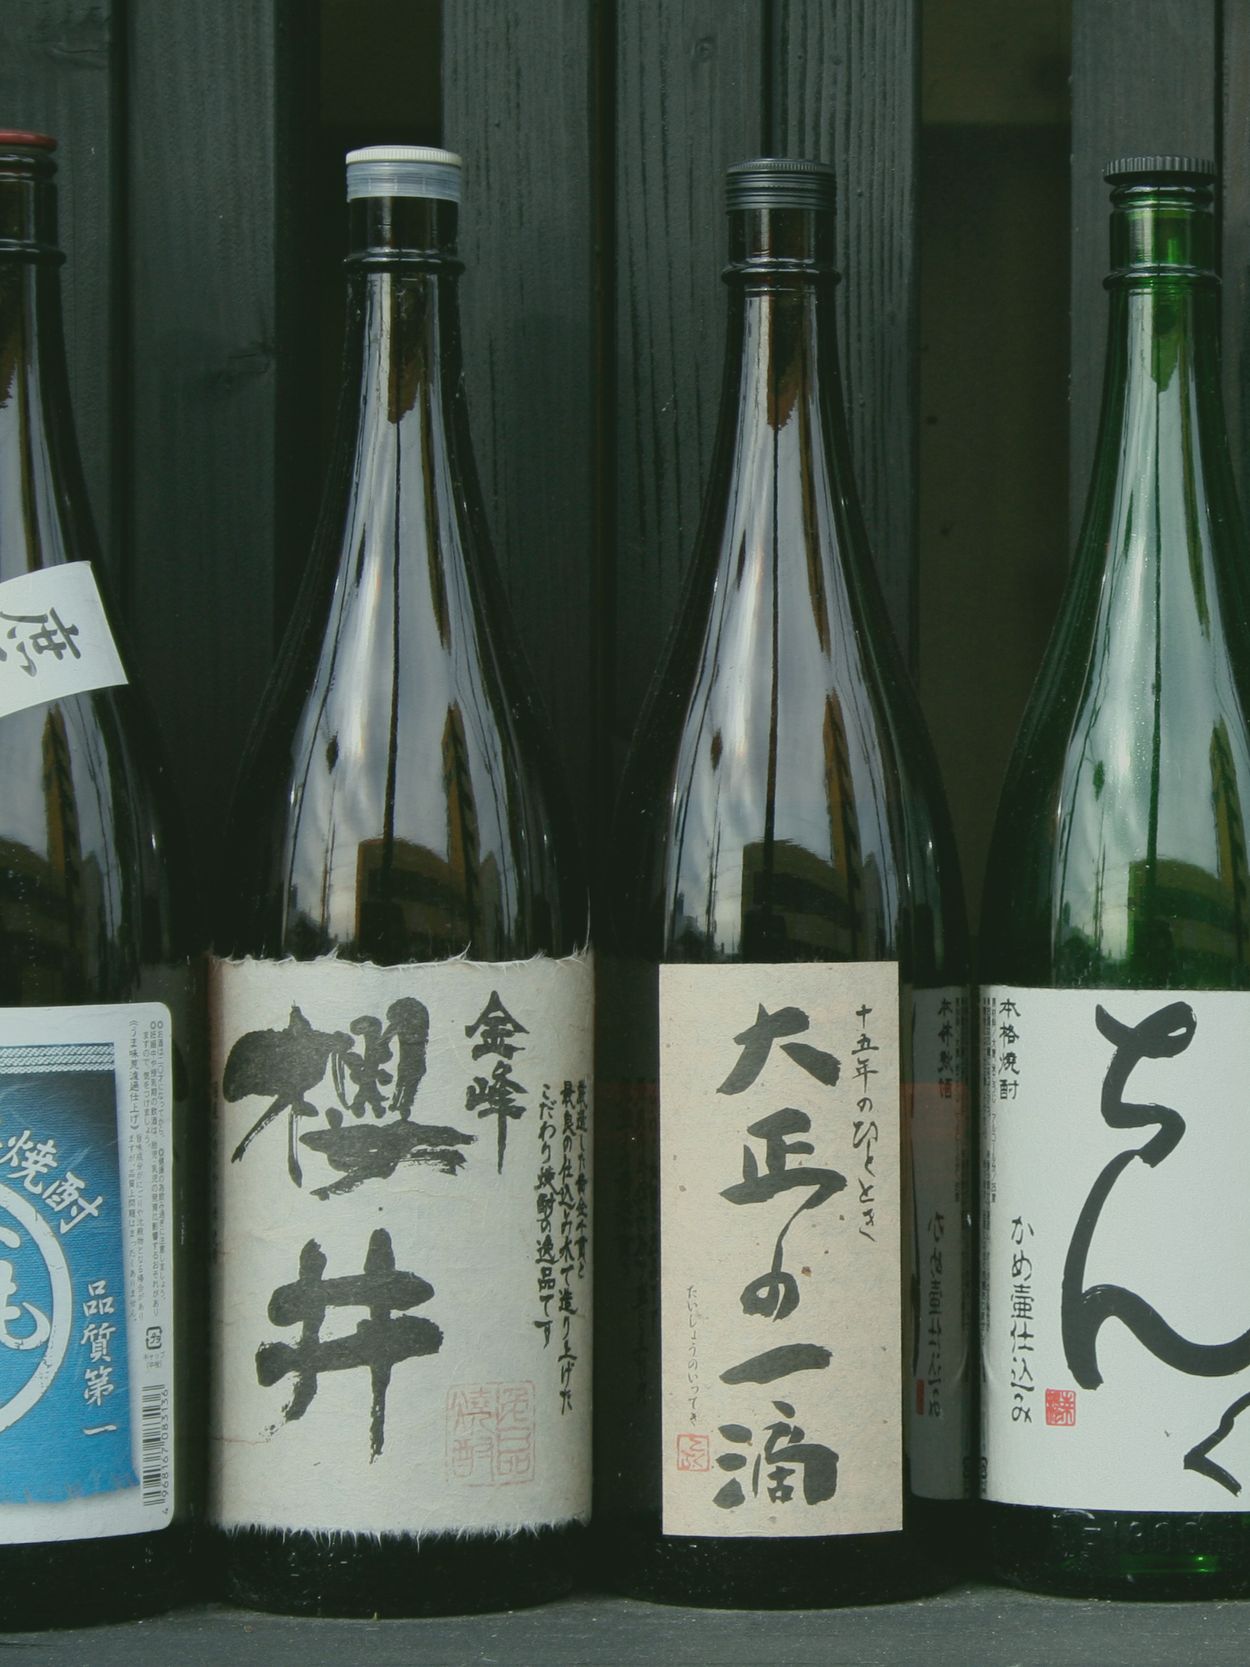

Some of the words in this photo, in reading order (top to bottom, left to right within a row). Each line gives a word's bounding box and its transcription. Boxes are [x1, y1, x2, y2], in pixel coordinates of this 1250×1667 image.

[465, 991, 530, 1175] 金峰
[851, 1003, 880, 1242] 十五年のひととき
[712, 1002, 848, 1510] 大正の一滴
[81, 1279, 118, 1438] 品質第一
[687, 1285, 699, 1427] たいしょうのいってき
